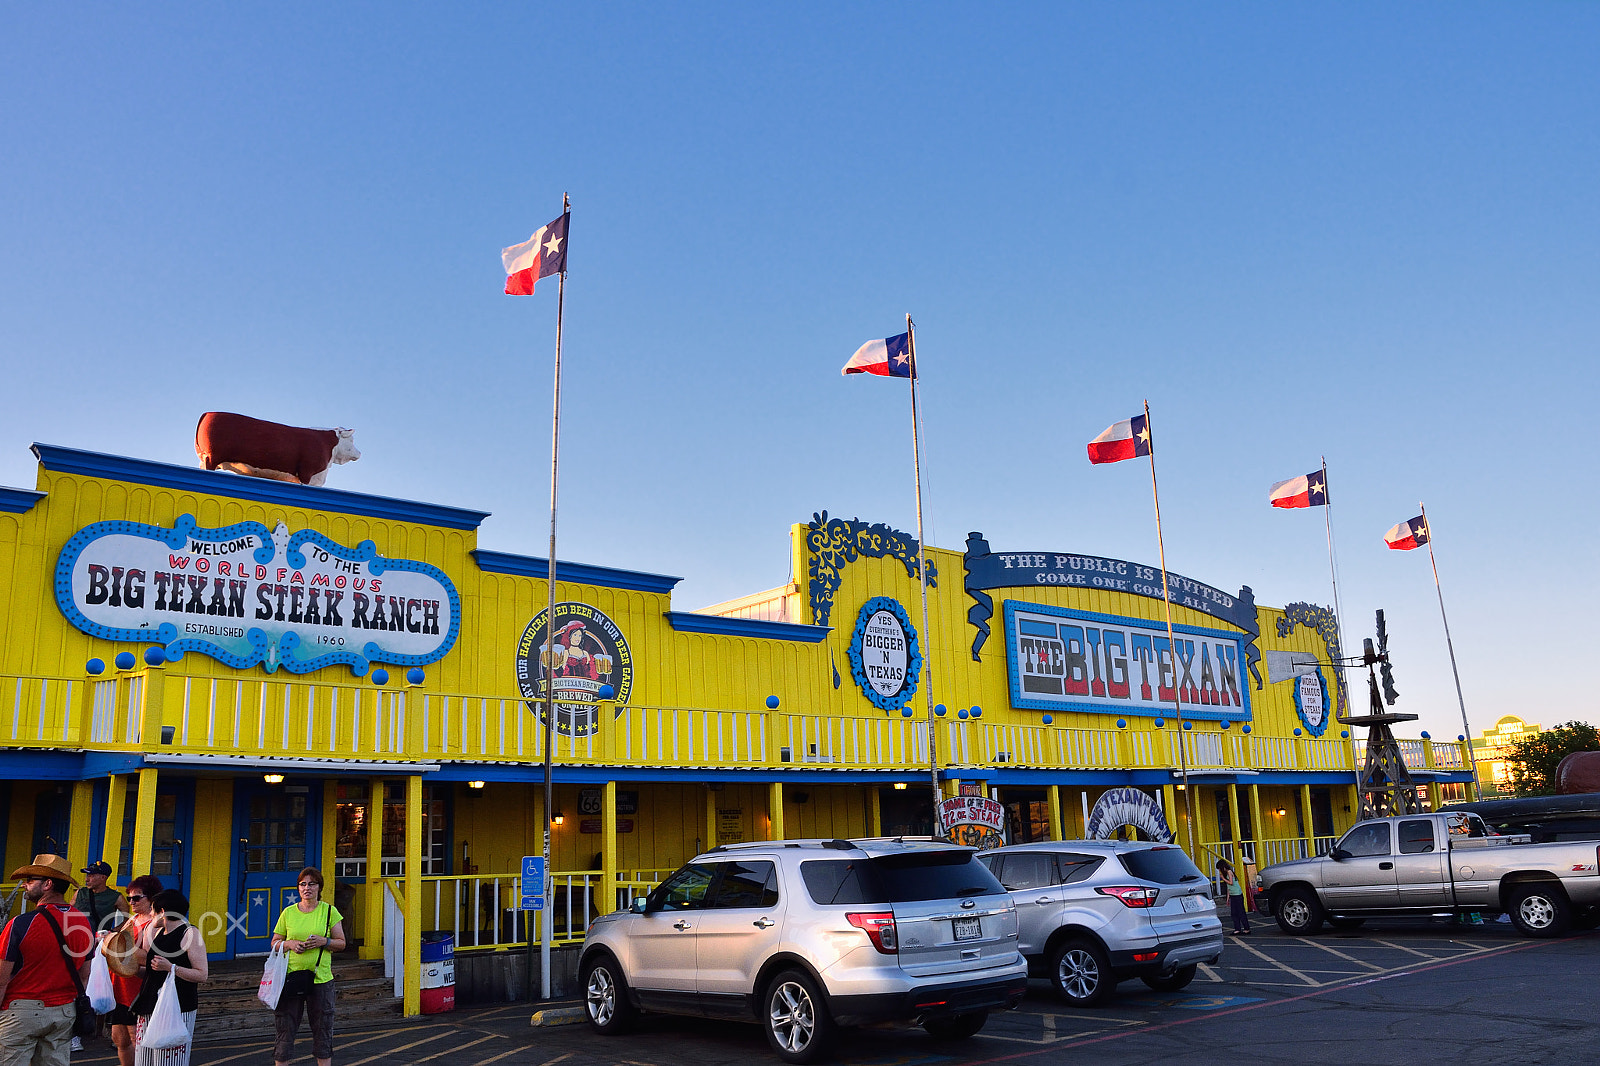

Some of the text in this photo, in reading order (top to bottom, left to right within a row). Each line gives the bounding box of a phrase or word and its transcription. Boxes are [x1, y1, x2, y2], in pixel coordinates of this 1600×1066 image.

[191, 537, 254, 556] WELCOME
[313, 547, 361, 575] TO THE
[999, 554, 1047, 569] THE
[1055, 555, 1127, 576] PUBLIC
[1135, 565, 1154, 581] IS
[169, 554, 383, 593] WORLD FAMOUS
[85, 563, 441, 635] BIG TEXAN STEAK RANCH
[1035, 573, 1086, 584] COME
[1133, 584, 1176, 601] COME
[1183, 596, 1210, 612] ALL
[877, 615, 892, 626] YES
[185, 623, 244, 639] ESTABLISHED
[519, 605, 568, 657] HANDCRAED
[570, 605, 593, 618] BEER
[592, 612, 604, 625] IN
[603, 621, 619, 640] OUR
[615, 639, 630, 665] BEER
[316, 636, 346, 647] 1960
[865, 634, 904, 651] BIGGER
[1020, 637, 1063, 676] THE
[1059, 624, 1242, 707] BIG TEXAN
[868, 665, 903, 681] TEXAS
[557, 691, 593, 702] BREWED
[1301, 687, 1321, 697] FAMOUS
[583, 797, 600, 810] 66
[943, 798, 966, 812] HOME
[967, 798, 975, 807] OF
[976, 799, 984, 808] THE
[1100, 788, 1144, 809] TEXAN
[969, 807, 1001, 826] STEAK
